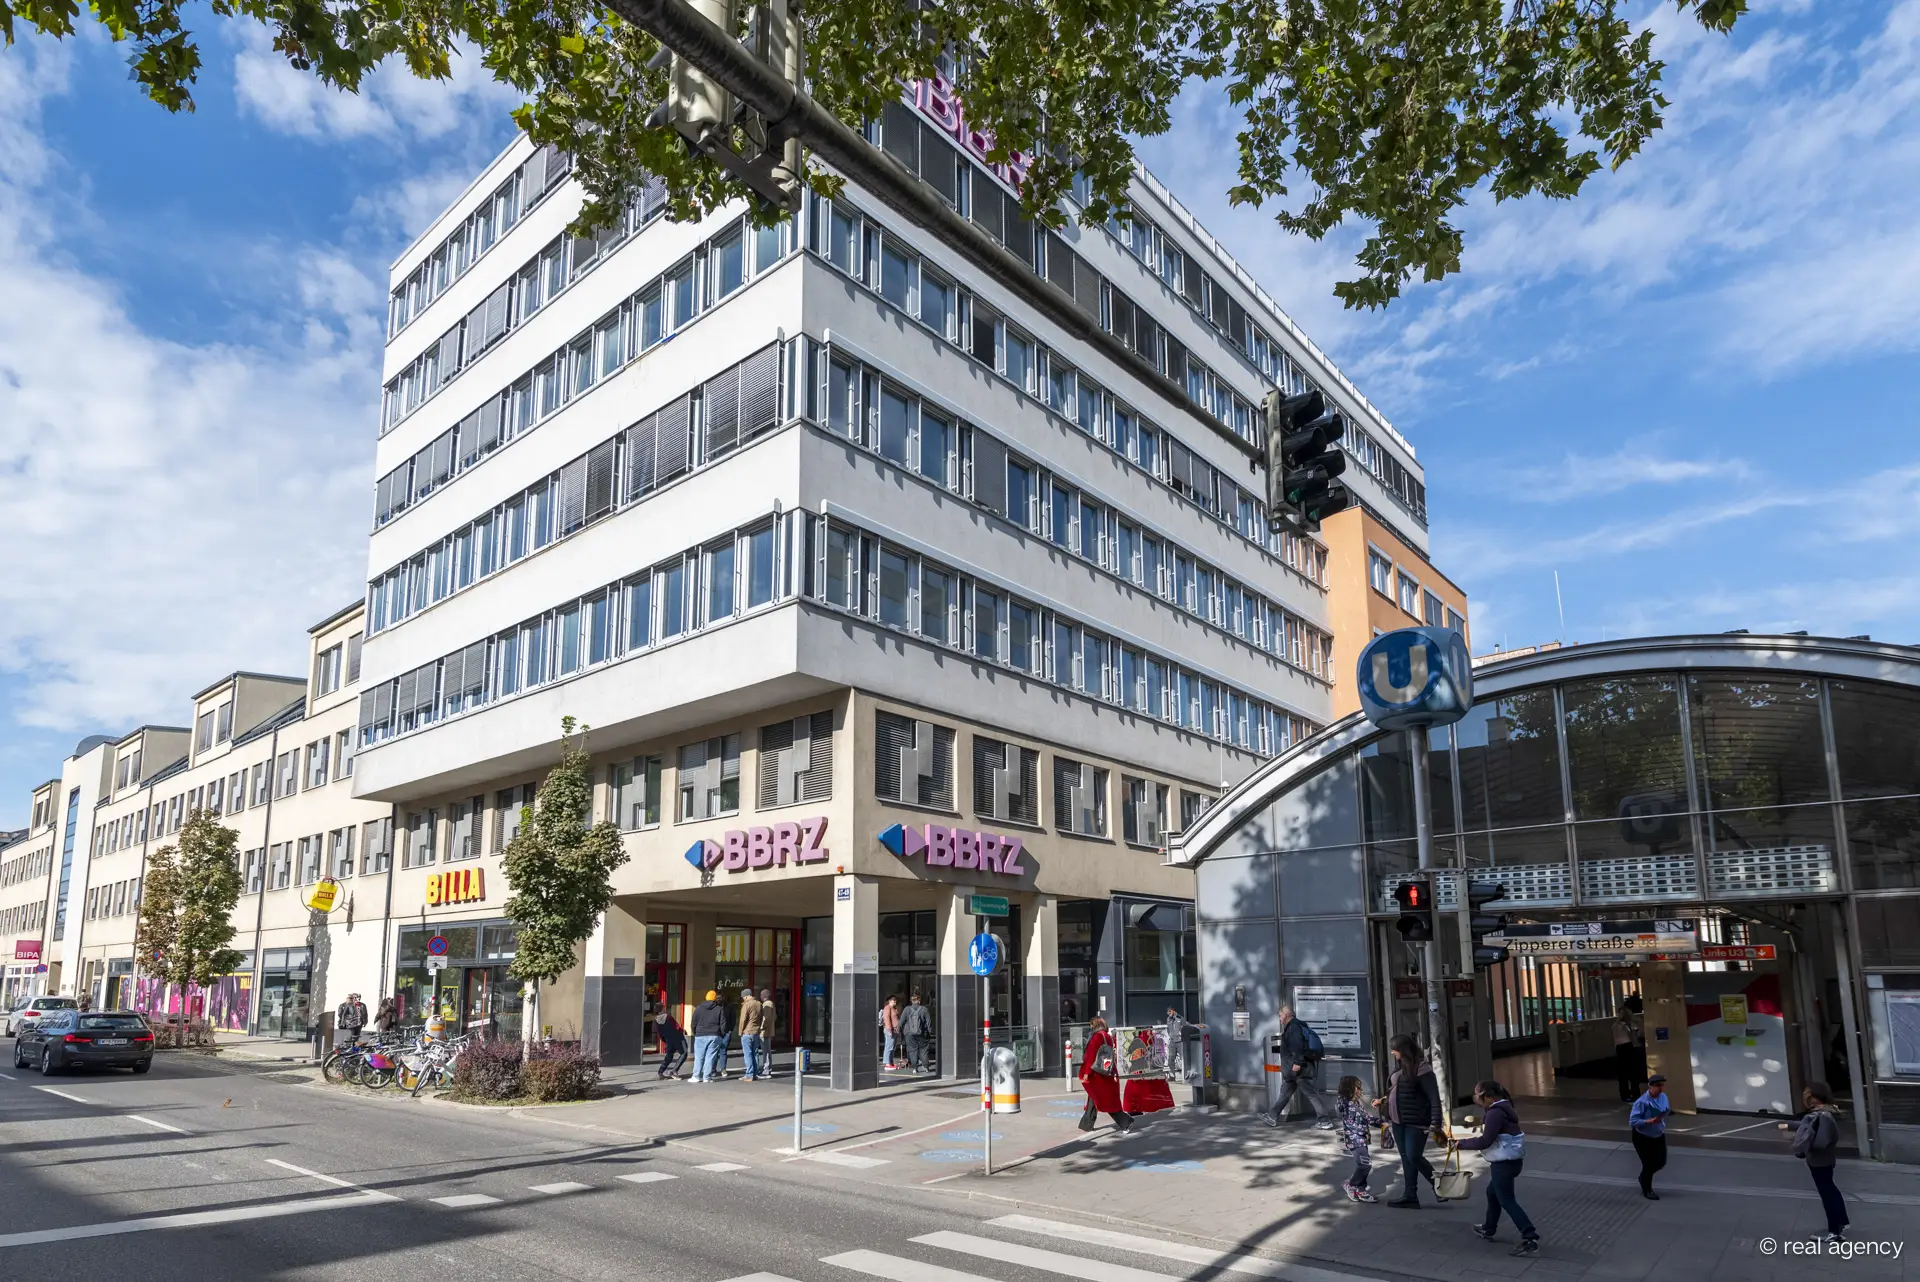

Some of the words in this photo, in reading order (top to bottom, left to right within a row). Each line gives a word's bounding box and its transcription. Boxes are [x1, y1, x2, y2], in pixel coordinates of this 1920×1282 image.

[1371, 645, 1428, 704] U
[1451, 644, 1471, 712] U
[724, 816, 829, 871] BBRZ
[924, 824, 1024, 875] BBRZ
[426, 867, 484, 906] BILLA
[16, 951, 39, 959] BIPA
[1503, 936, 1634, 952] Zippererstraße
[1702, 948, 1727, 958] Linie
[1729, 948, 1744, 957] U3
